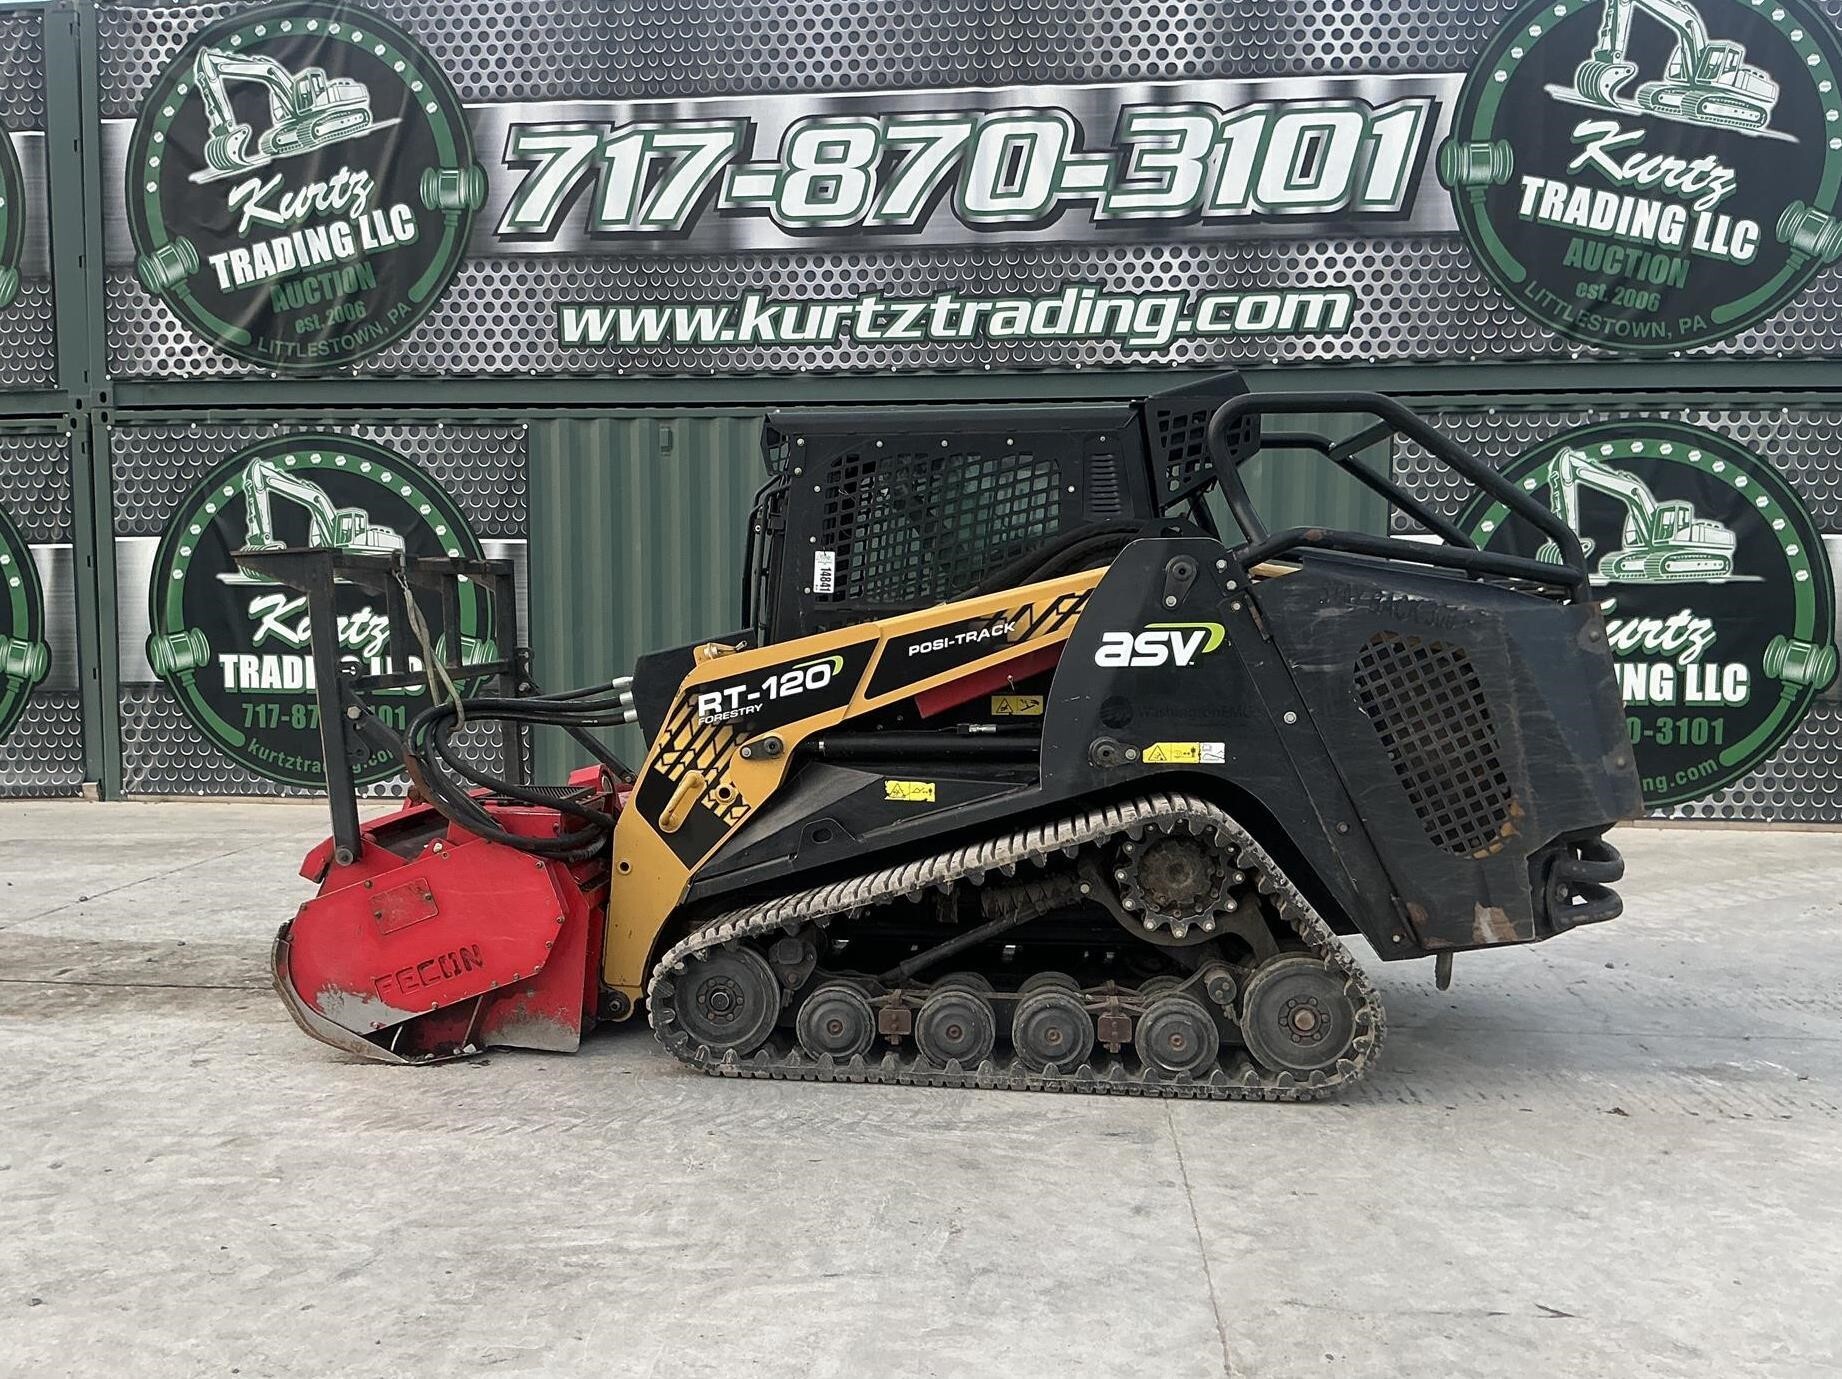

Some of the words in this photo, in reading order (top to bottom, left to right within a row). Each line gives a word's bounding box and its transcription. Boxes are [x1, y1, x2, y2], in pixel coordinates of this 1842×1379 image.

[504, 102, 1429, 231] 717-870-3101
[1569, 119, 1737, 212] Kurtz
[228, 166, 374, 236] Kurtz
[1519, 176, 1687, 246] TRADING
[1692, 211, 1760, 260] LLC
[208, 221, 356, 290] TRADING
[359, 203, 415, 250] LLC
[1562, 238, 1691, 289] AUCTION
[270, 261, 377, 314] AUCTION
[1524, 280, 1673, 339] LITTLESTOWN,
[1679, 314, 1708, 334] PA
[1575, 281, 1609, 300] est.
[1611, 286, 1661, 312] 2006
[257, 325, 388, 358] LITTLESTOWN,
[388, 301, 412, 325] PA
[295, 313, 325, 334] est.
[327, 301, 367, 326] 2006
[560, 285, 1352, 348] www.kurtztrading.com
[819, 567, 832, 592] 14841
[908, 621, 1016, 657] POSI-TRACK
[1601, 598, 1717, 667] urtz
[698, 663, 832, 717] RT-120
[1684, 662, 1748, 703] LLC
[698, 703, 763, 726] FORESTRY
[374, 943, 483, 1003] FECON
